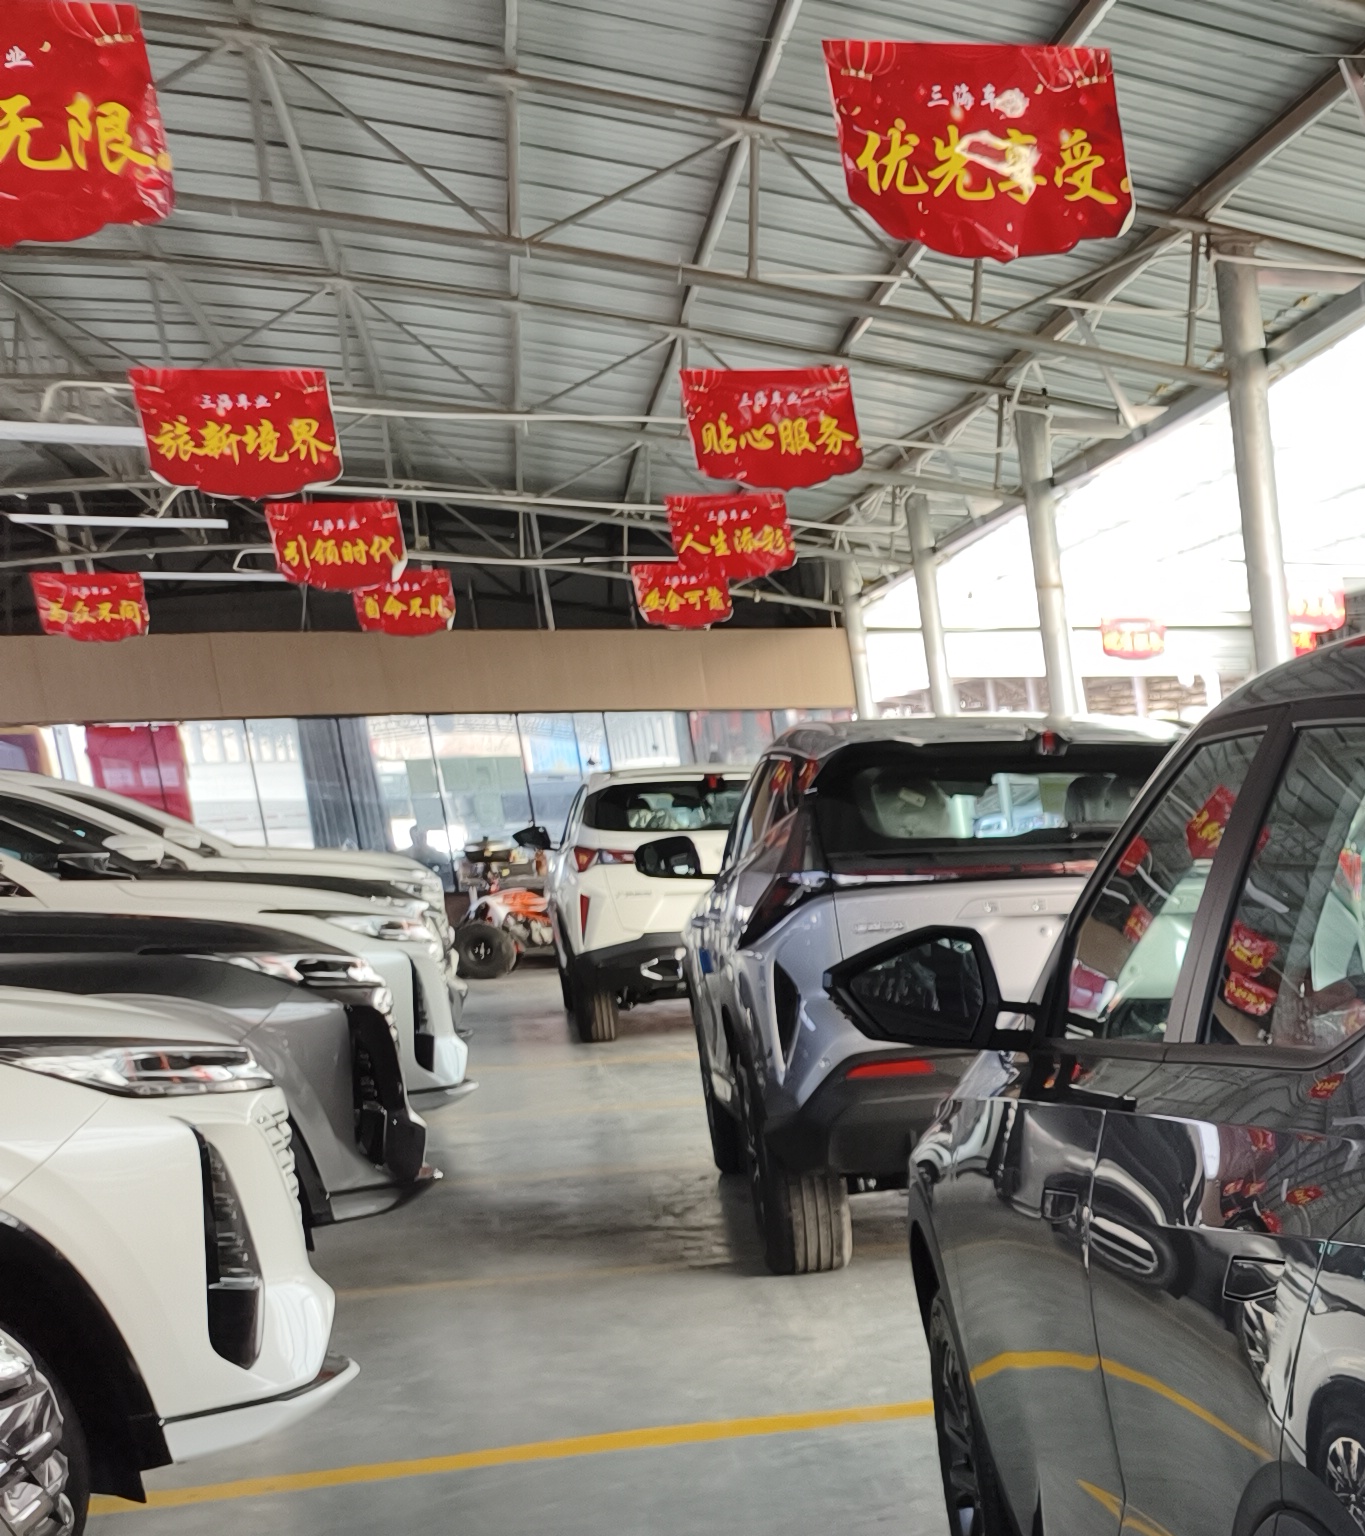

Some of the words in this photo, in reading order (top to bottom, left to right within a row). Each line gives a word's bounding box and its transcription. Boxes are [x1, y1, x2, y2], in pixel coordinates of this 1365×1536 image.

[700, 416, 856, 457] 贴心服务
[282, 533, 402, 570] 引领时代
